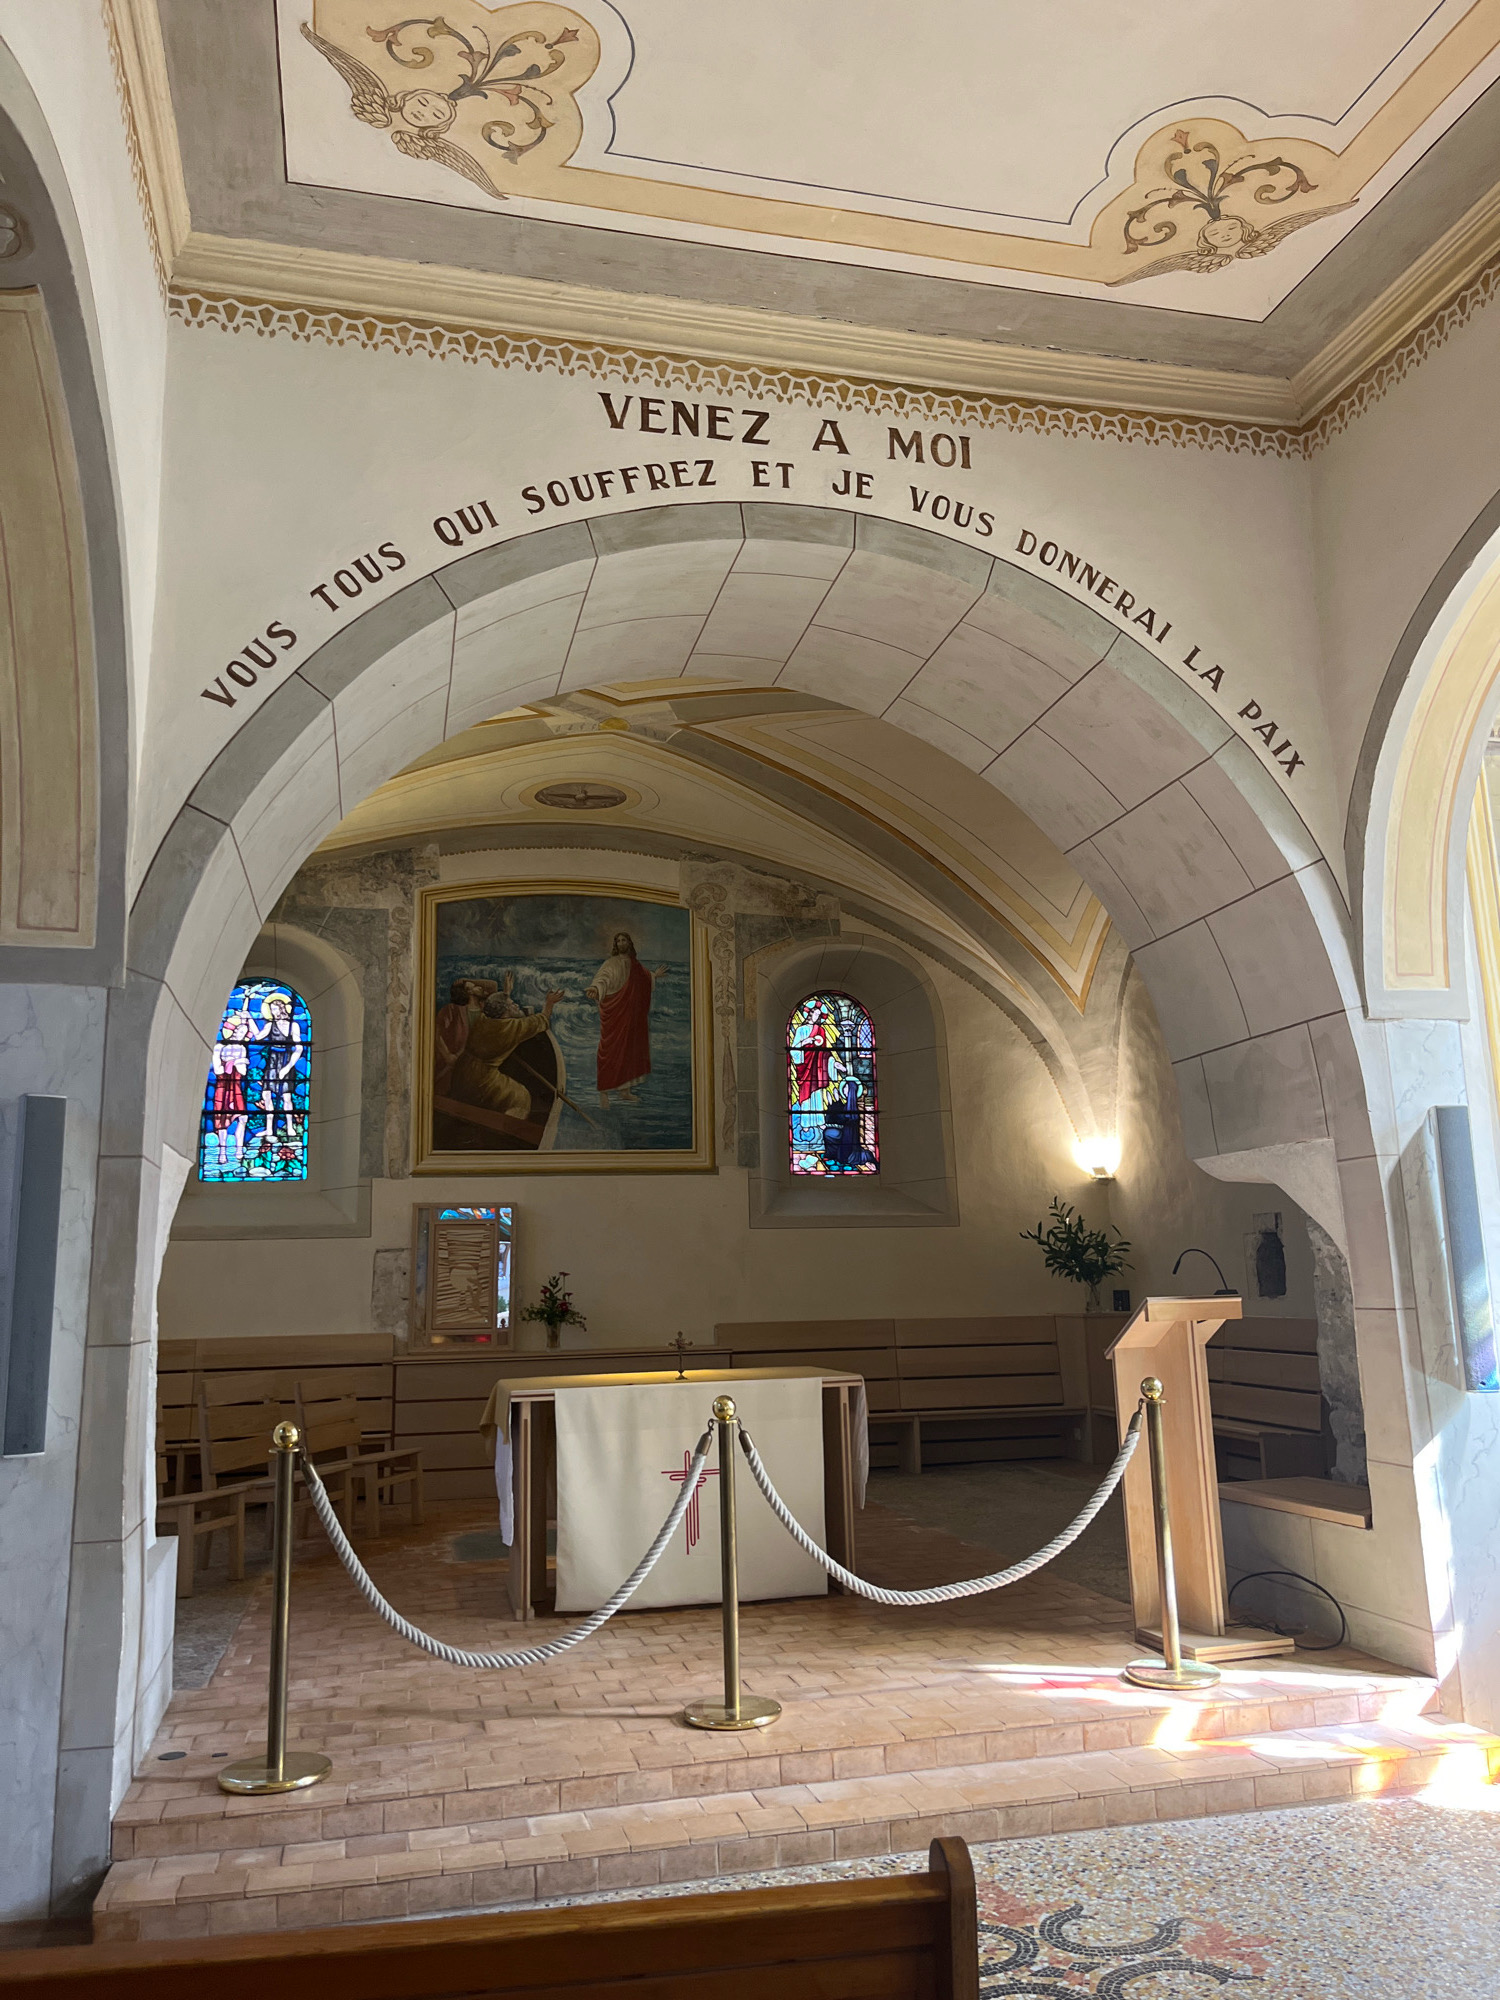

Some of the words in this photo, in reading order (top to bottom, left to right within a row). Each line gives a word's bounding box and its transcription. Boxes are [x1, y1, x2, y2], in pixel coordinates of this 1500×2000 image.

[597, 392, 771, 445] VENEZ
[812, 419, 851, 456] A
[887, 427, 972, 469] MOI
[200, 621, 298, 708] VOUS
[310, 542, 407, 612] TOUS
[433, 500, 500, 547] QUI
[522, 460, 717, 514] SOUFFREZ
[751, 461, 795, 488] ET
[832, 470, 875, 499] JE
[909, 485, 996, 537] VOUS
[1015, 529, 1172, 643] DONNERAI
[1183, 645, 1225, 693] LA
[1237, 699, 1306, 778] PAIX
